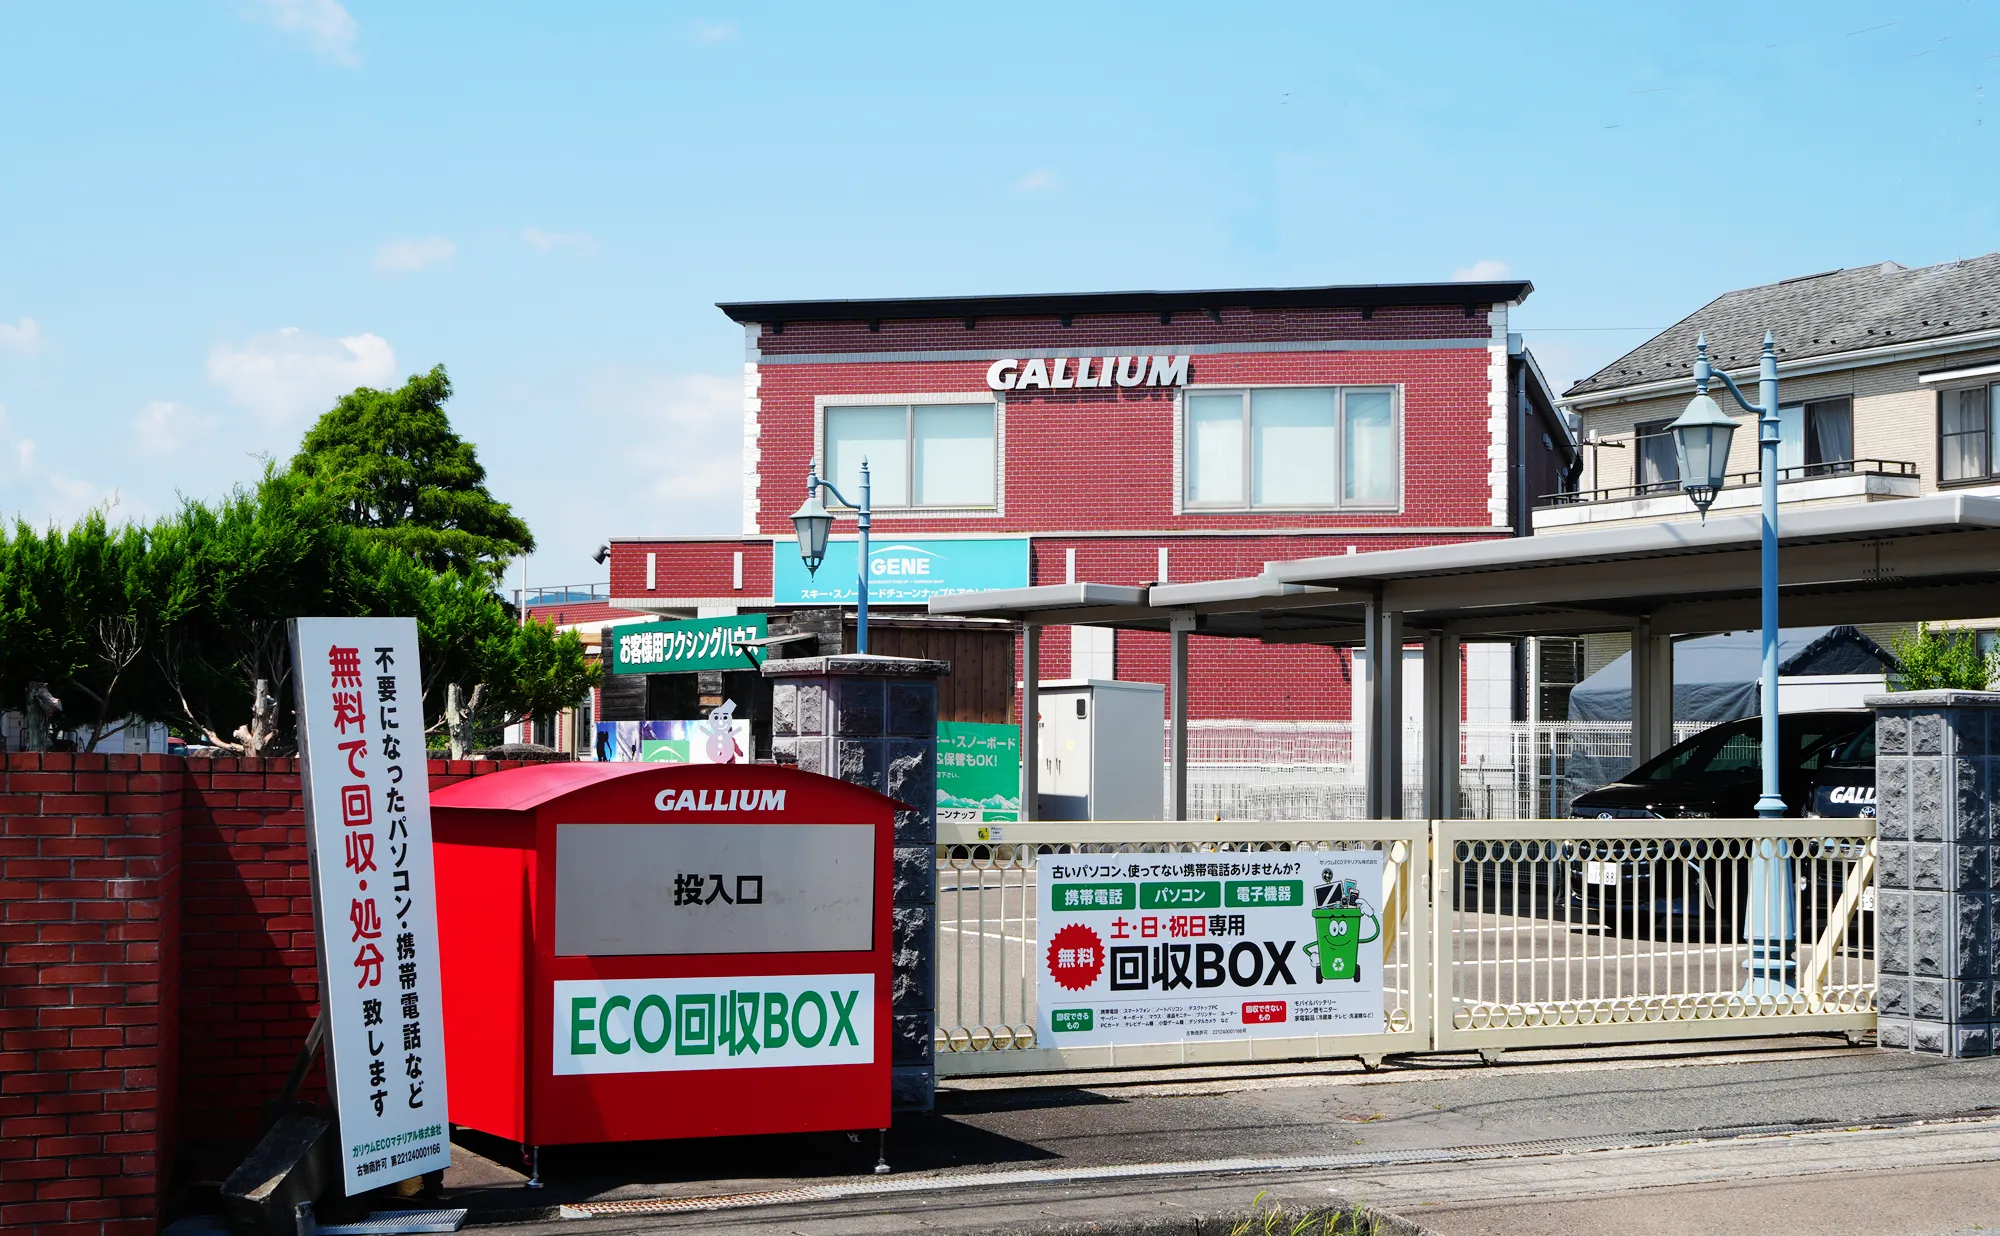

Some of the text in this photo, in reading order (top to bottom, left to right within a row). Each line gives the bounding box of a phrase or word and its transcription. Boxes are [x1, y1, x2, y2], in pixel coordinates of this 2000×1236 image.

[986, 355, 1190, 390] GALLIUM
[870, 558, 930, 576] GENE
[654, 788, 787, 812] GALLIUM
[374, 647, 425, 1108] 不要になったパソコン・携帯電話など
[673, 873, 764, 906] 投入口
[1064, 888, 1123, 906] 携帯電話
[1154, 888, 1206, 903] パソコン
[1236, 885, 1291, 903] 電子機器
[1057, 947, 1095, 968] 無料
[1110, 940, 1297, 991] 回収BOX
[1056, 1012, 1089, 1021] 回収できる
[1245, 1005, 1283, 1014] 回収できない
[1258, 1013, 1271, 1021] もの
[570, 989, 860, 1057] ECO回収BOX
[1066, 1021, 1080, 1030] もの
[352, 1124, 442, 1158] ガリウムECOマテリアル株式会社
[357, 1143, 441, 1177] 古物商許可 第221240001166
